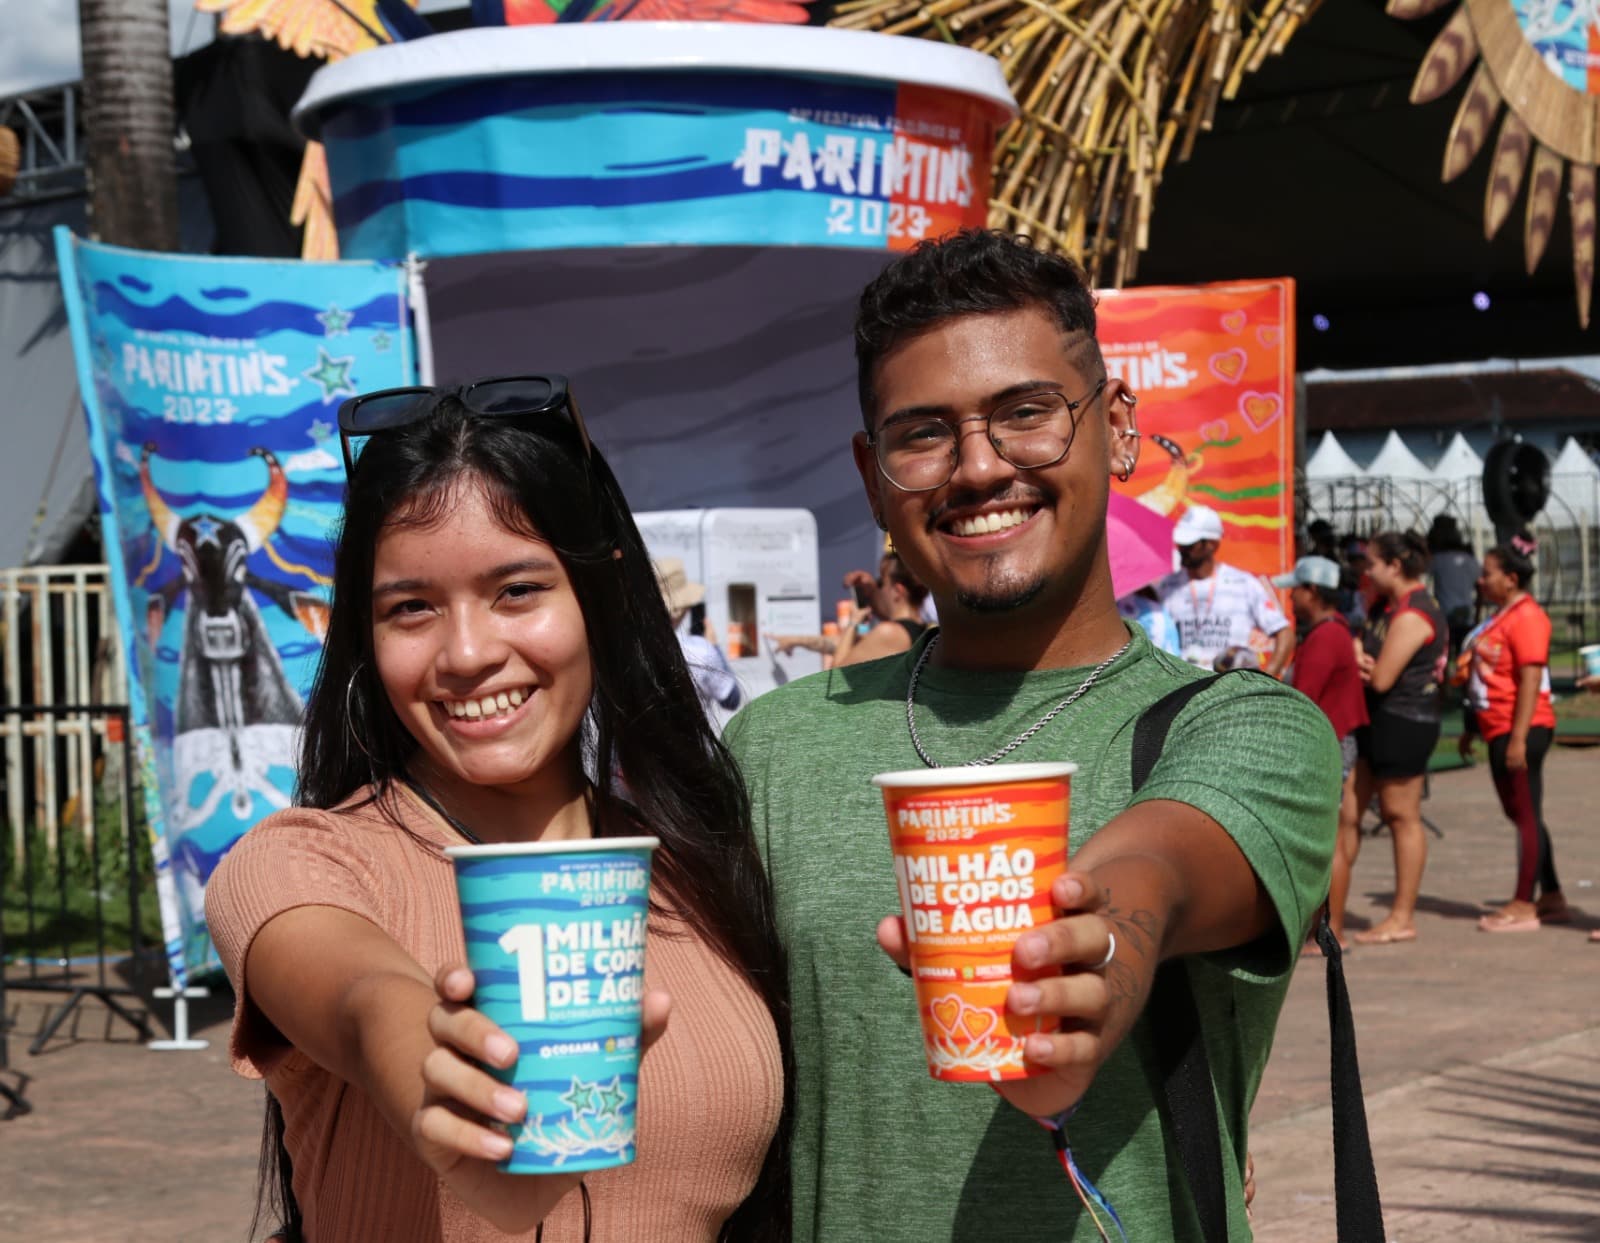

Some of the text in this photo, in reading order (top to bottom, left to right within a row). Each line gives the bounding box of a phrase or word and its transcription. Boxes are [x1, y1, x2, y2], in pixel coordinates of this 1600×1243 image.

[732, 127, 975, 207] PARINTINS
[826, 198, 932, 238] 2023
[122, 343, 299, 395] PARINTINS
[163, 396, 239, 425] 2023
[898, 802, 1016, 829] PARINTINS
[906, 844, 1036, 882] MILHÃO
[911, 877, 1035, 905] DE COPOS
[914, 902, 1033, 934] DE ÁGUA
[498, 912, 648, 1022] 1 MILHÃ
[548, 952, 587, 977] DE
[549, 979, 591, 1007] DE
